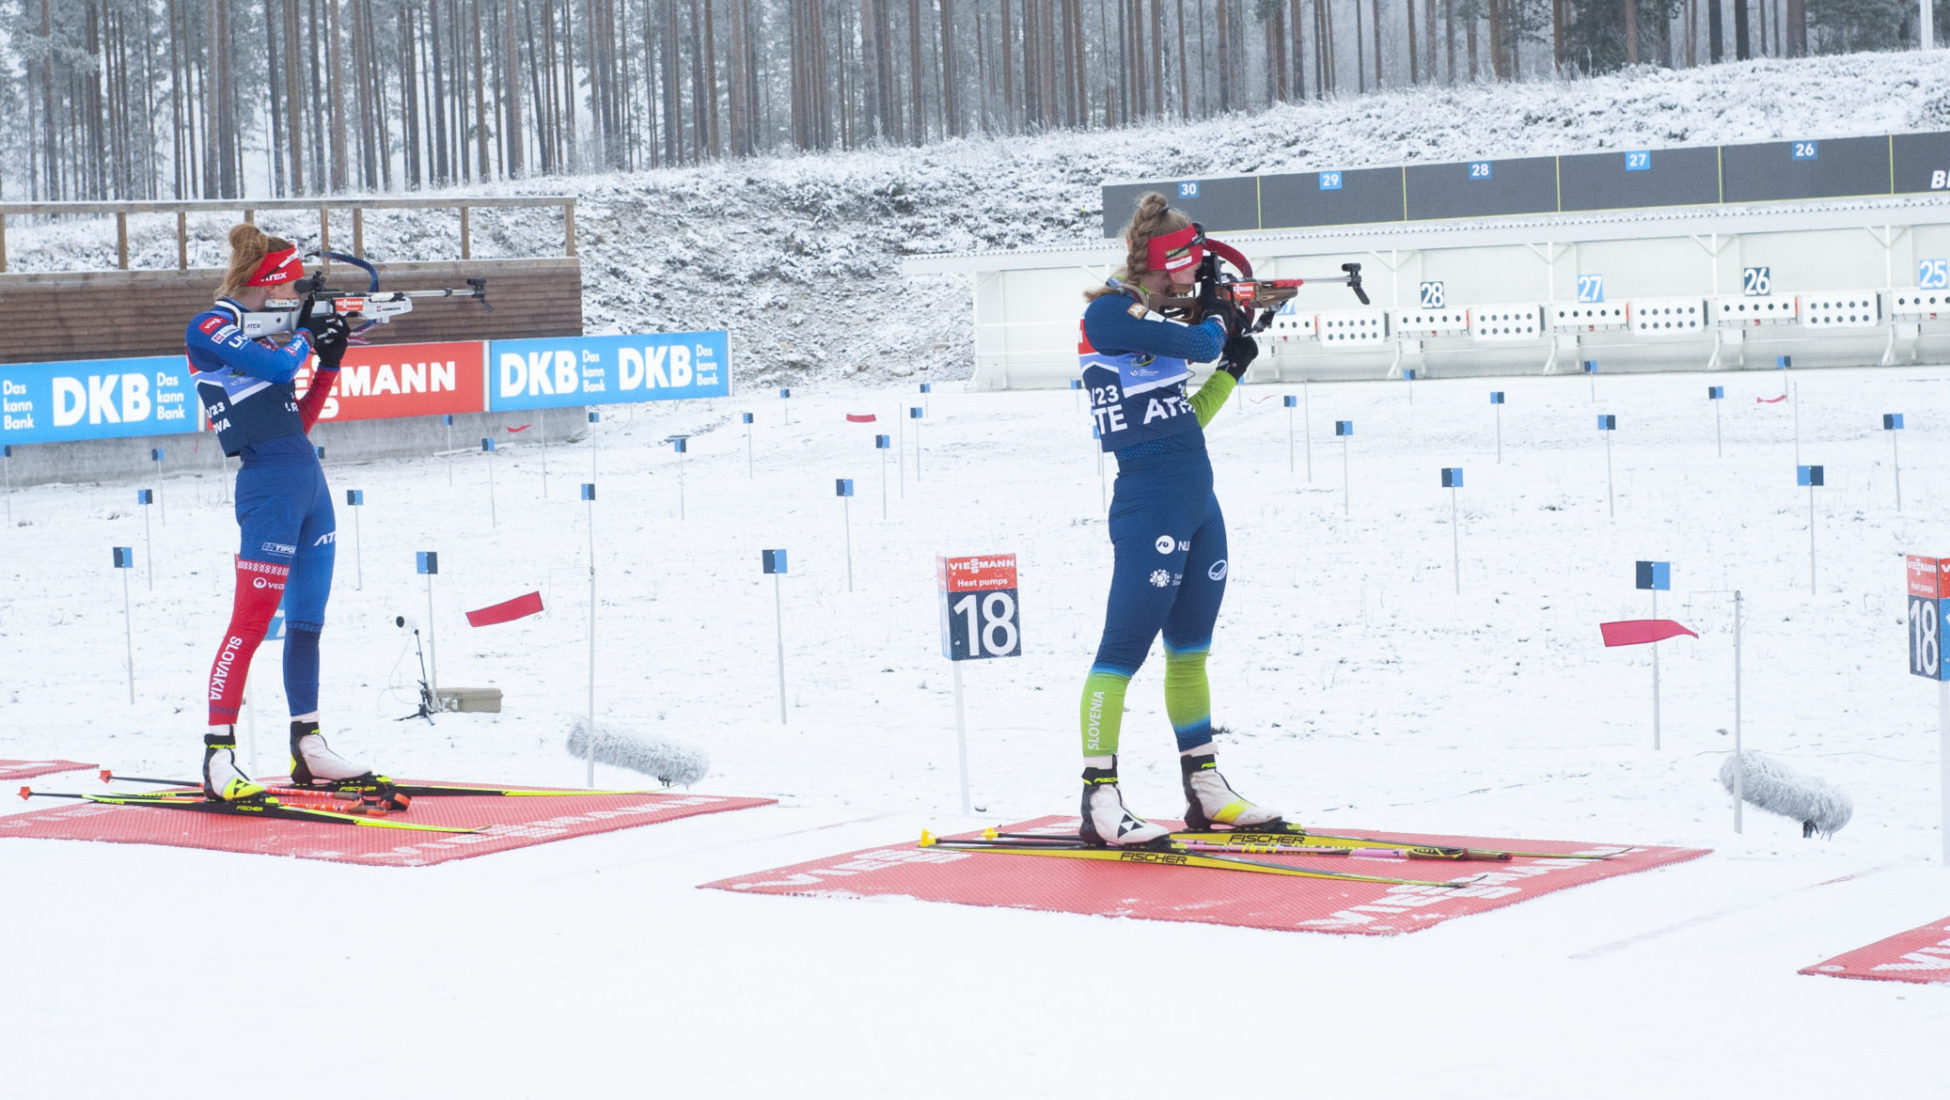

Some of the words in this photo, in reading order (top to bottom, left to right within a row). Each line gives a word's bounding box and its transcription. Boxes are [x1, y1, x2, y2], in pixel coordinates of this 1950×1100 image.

[1796, 143, 1815, 157] 26
[1629, 153, 1647, 167] 27
[1471, 163, 1489, 177] 28
[1322, 173, 1339, 187] 29
[1181, 183, 1197, 196] 30
[1745, 267, 1770, 295] 26
[1919, 261, 1946, 288] 25
[1421, 282, 1444, 308] 28
[1578, 276, 1602, 301] 27
[582, 350, 600, 363] Das
[696, 344, 713, 357] Das
[500, 350, 579, 397] DKB
[582, 365, 605, 378] kann
[618, 345, 693, 391] DKB
[697, 359, 718, 372] kann
[157, 372, 179, 388] Das
[582, 379, 606, 393] Bank
[697, 373, 719, 386] Bank
[3, 380, 27, 396] Das
[52, 373, 151, 427] DKB
[157, 389, 185, 404] kann
[3, 397, 33, 413] kann
[157, 405, 185, 421] Bank
[4, 414, 35, 431] Bank
[313, 531, 336, 547] AT
[949, 558, 1015, 574] VIESSMANN
[957, 579, 977, 588] Heat
[980, 578, 1008, 587] pumps
[953, 591, 1018, 657] 18
[1910, 599, 1938, 675] 18
[209, 636, 243, 700] SLOVAKIA
[1088, 691, 1104, 750] SLOVENIA
[1229, 834, 1305, 844] FISCHER
[1120, 852, 1188, 865] FISCHER
